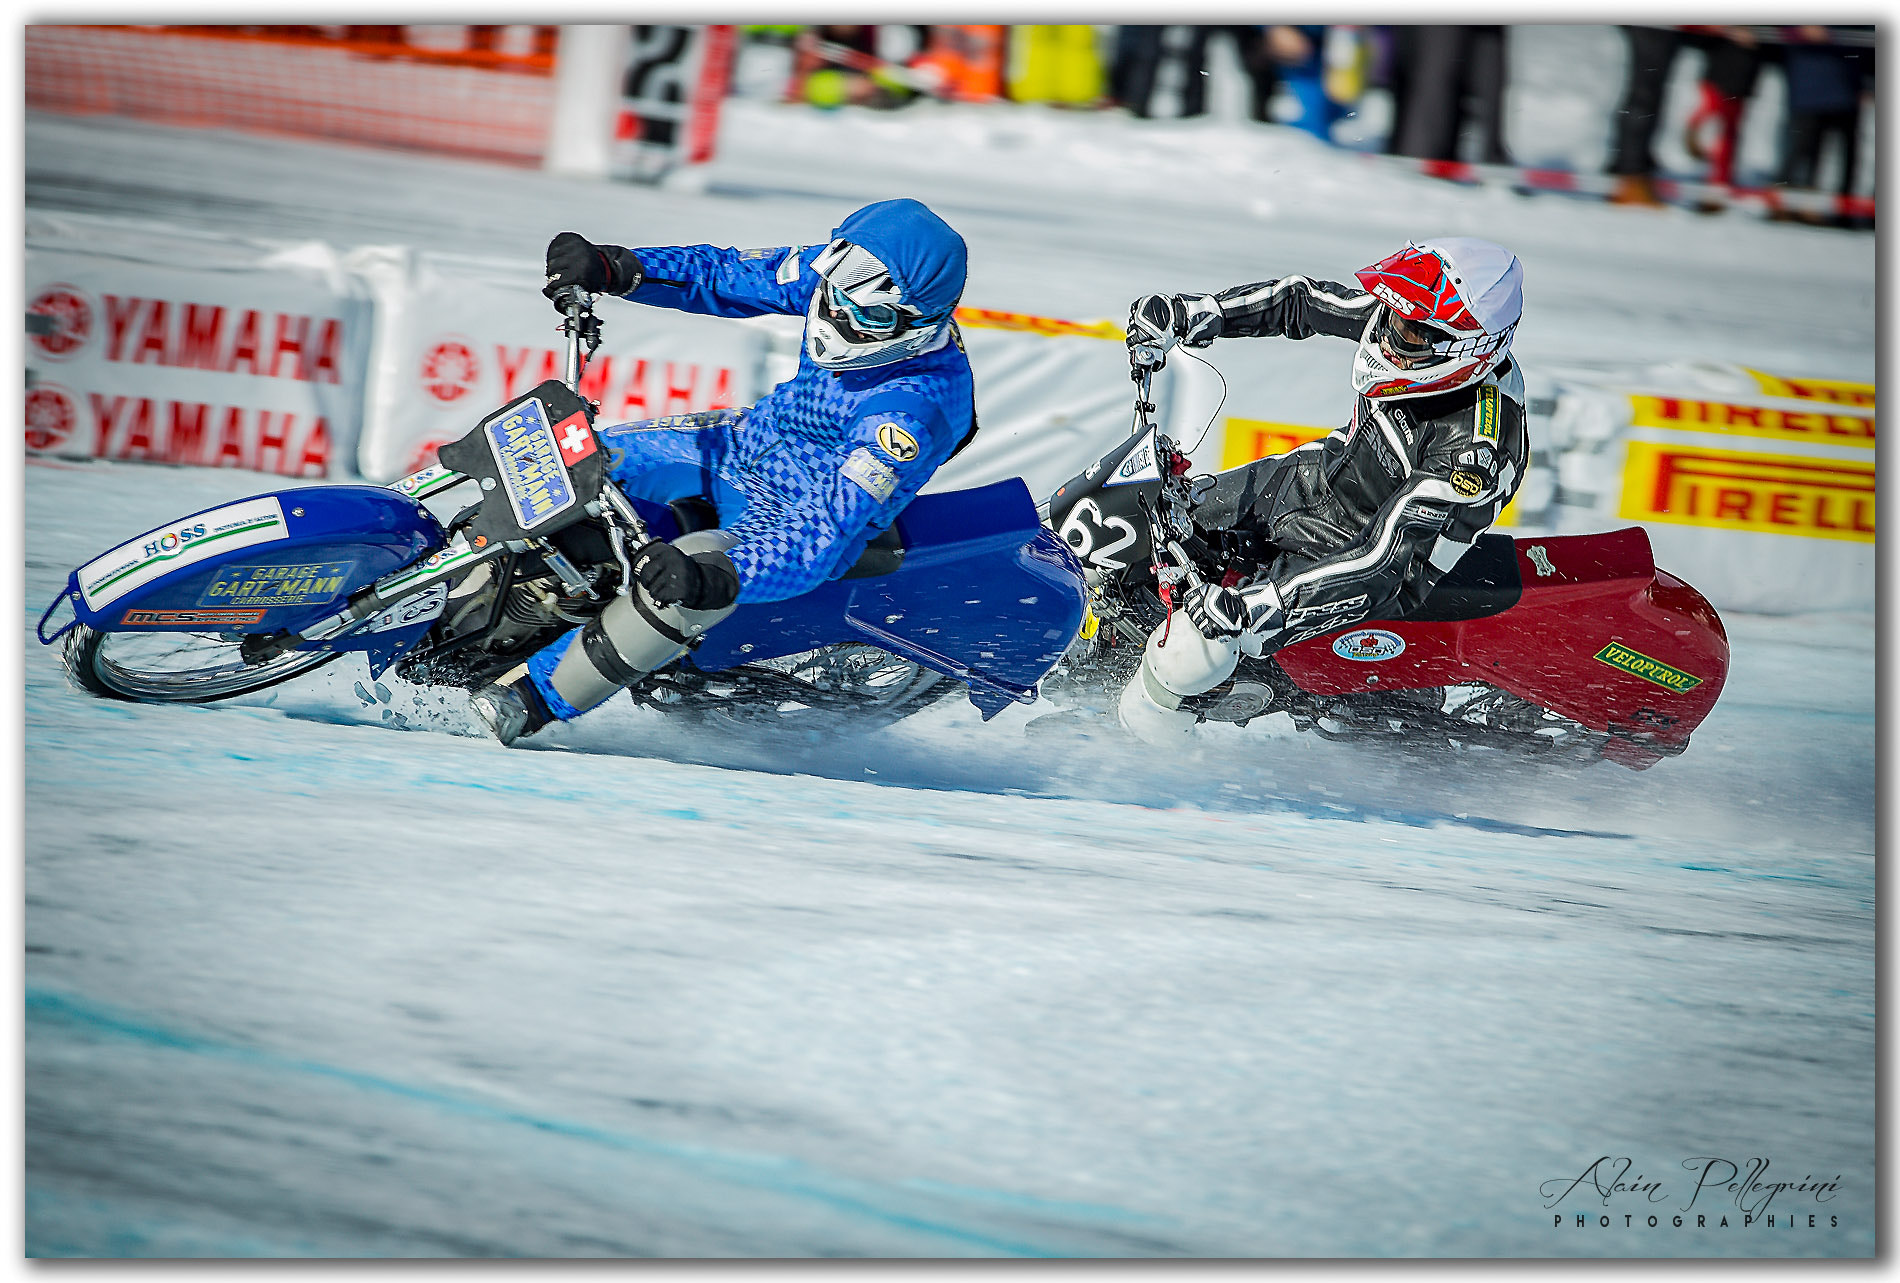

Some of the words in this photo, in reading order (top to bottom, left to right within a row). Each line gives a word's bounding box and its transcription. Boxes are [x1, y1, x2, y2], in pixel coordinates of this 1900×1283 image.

[102, 294, 343, 384] YAMAHA
[90, 393, 333, 479] YAMAHA
[529, 429, 561, 483] GARAGE
[143, 523, 207, 558] HOSS
[1059, 496, 1137, 570] 62
[251, 565, 323, 580] GARAGE
[1605, 647, 1689, 688] VELOPUROL
